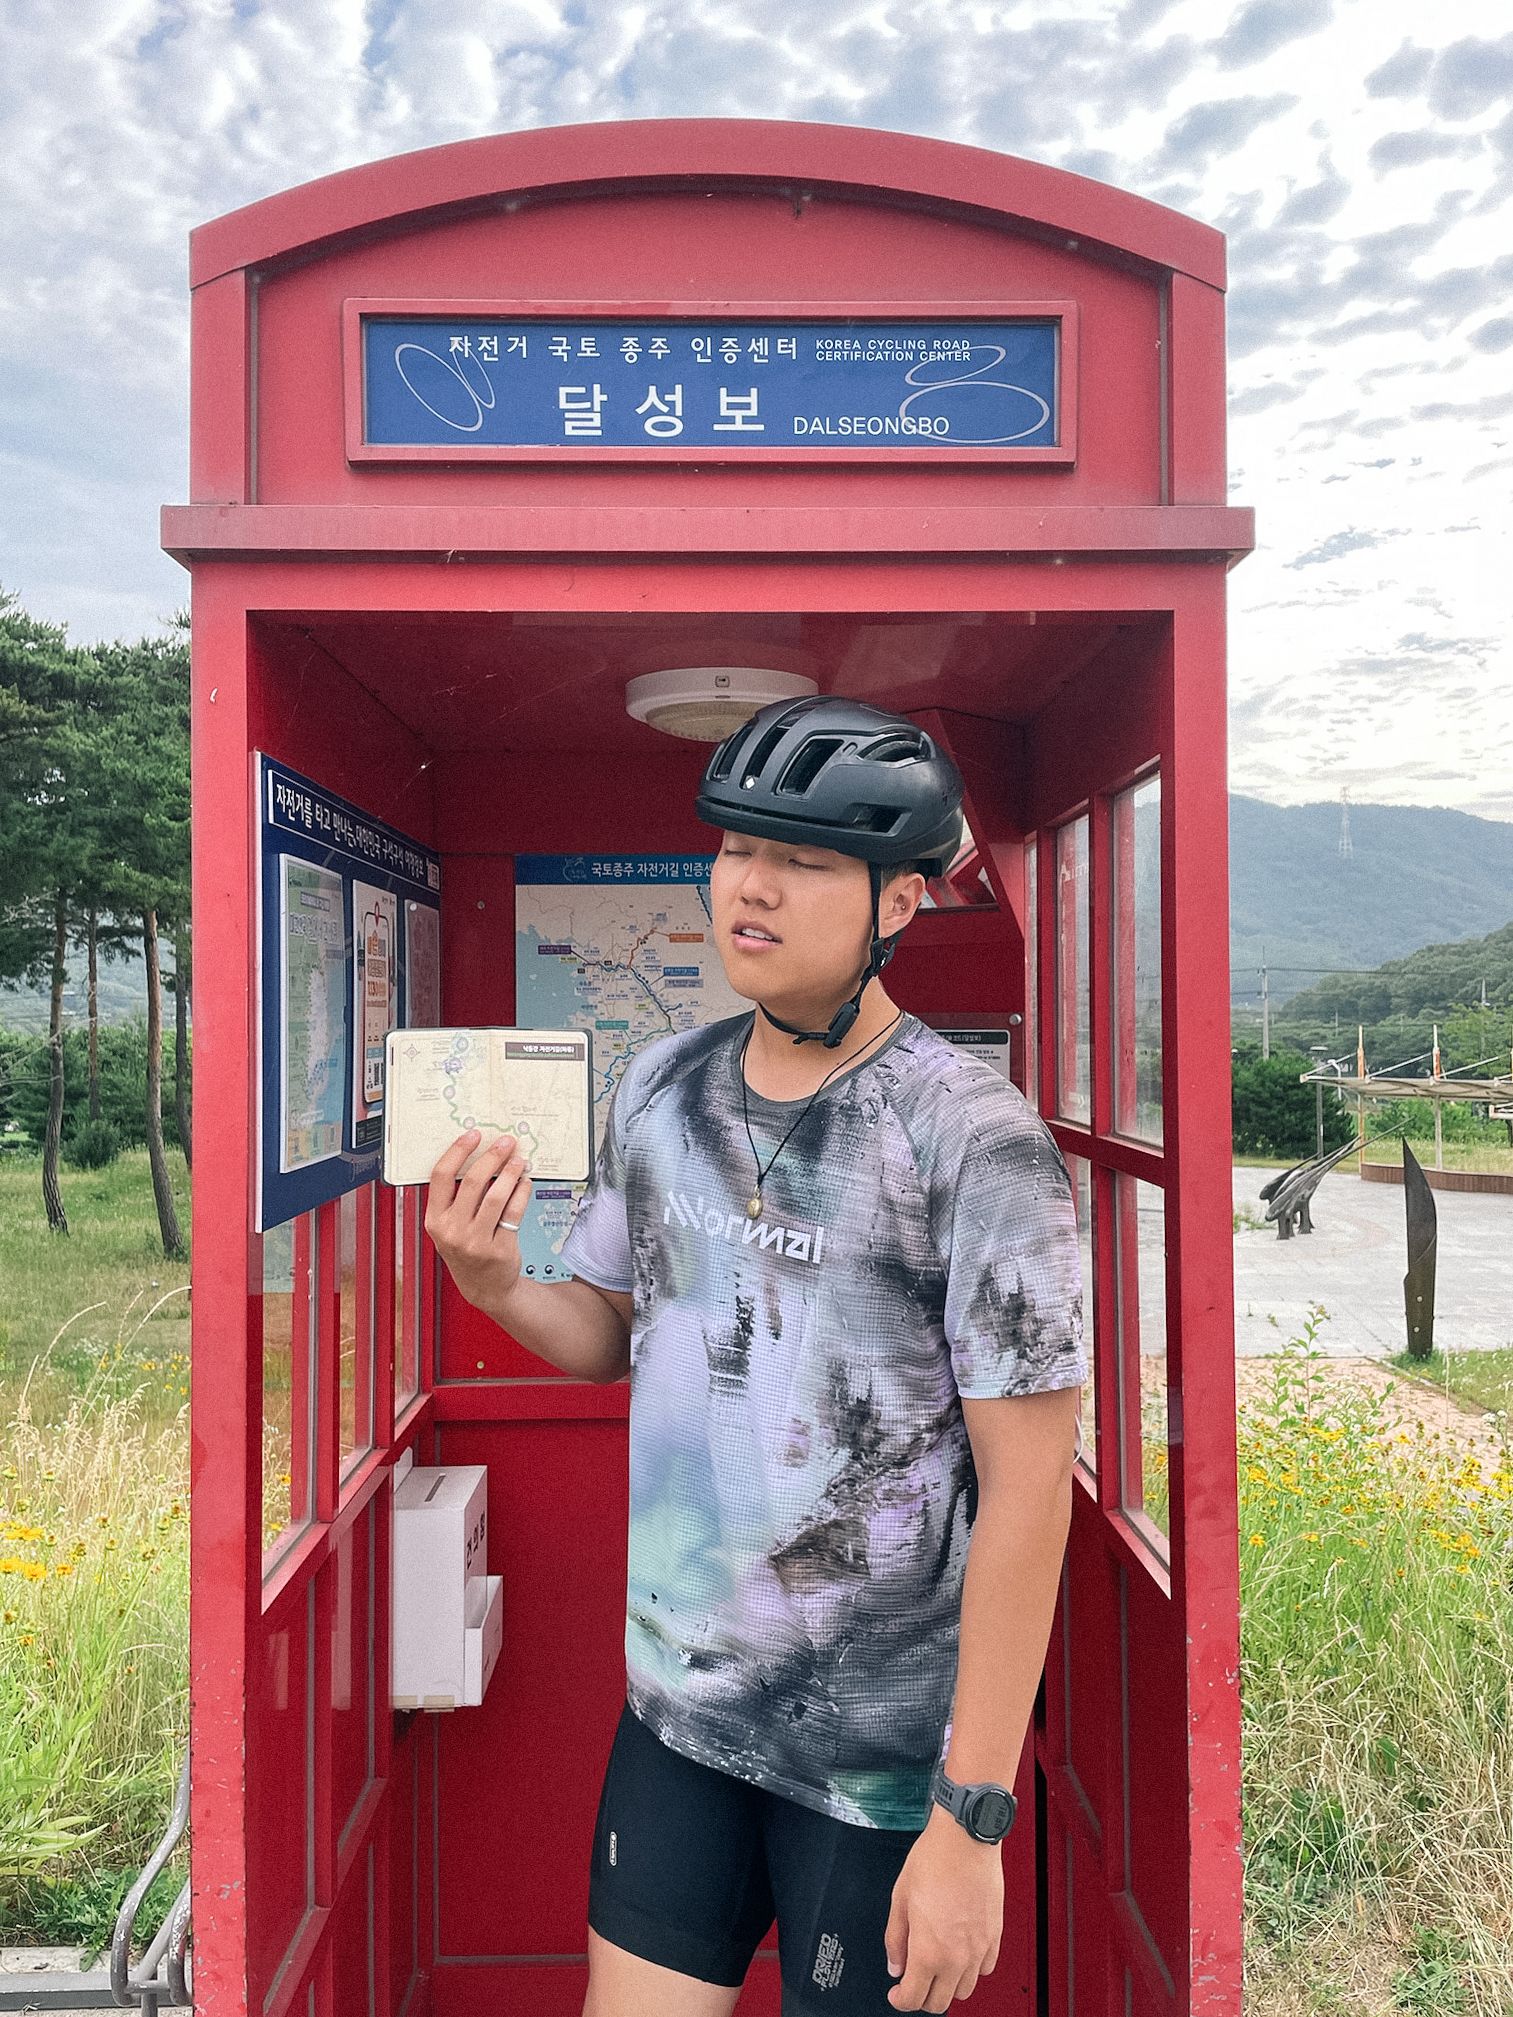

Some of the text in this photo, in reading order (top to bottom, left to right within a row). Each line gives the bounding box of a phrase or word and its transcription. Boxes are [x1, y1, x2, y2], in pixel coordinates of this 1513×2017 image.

[449, 336, 797, 364] 자전거 국토 종주 인증센터
[816, 339, 970, 350] KOREA CYCLING ROAD
[816, 351, 971, 361] CERTIFICATION CENTER
[558, 384, 765, 438] 달성보
[793, 416, 949, 435] DALSEONGBO
[276, 783, 313, 829] 자전거를
[315, 804, 331, 831] 타고
[355, 825, 381, 861] 대한민국
[591, 862, 634, 878] 국토종주
[637, 862, 679, 878] 자전거길
[682, 862, 711, 878] 인증센
